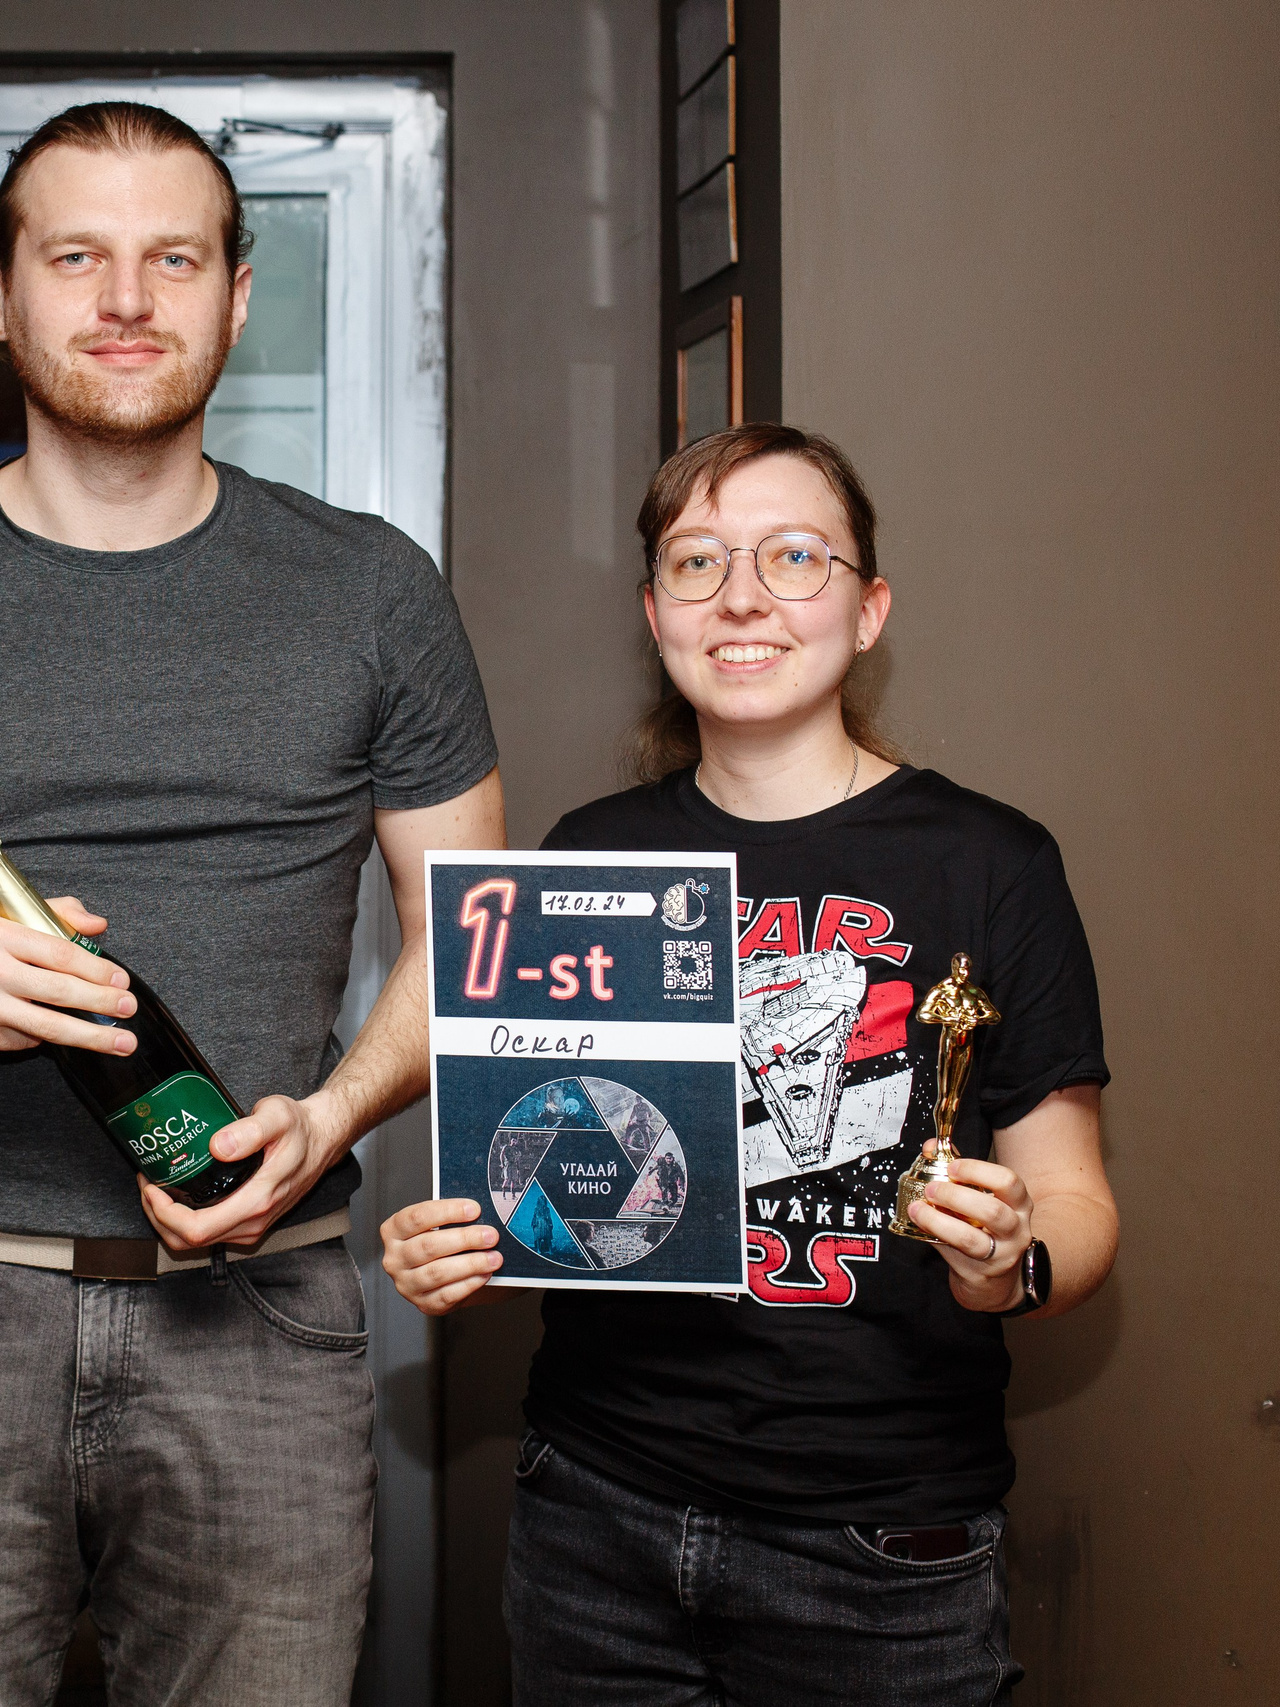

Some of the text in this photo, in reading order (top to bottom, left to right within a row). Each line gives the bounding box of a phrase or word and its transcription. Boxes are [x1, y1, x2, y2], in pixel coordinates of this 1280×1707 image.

[737, 893, 913, 967] AR
[663, 992, 714, 1001] vk.com/bigquiz
[490, 1024, 594, 1057] Оскар
[128, 1108, 198, 1156] BOSCA
[139, 1120, 210, 1166] ANNA FEDERICA
[560, 1160, 617, 1177] УГАДАЙ
[567, 1181, 611, 1195] КИНО
[746, 1224, 880, 1308] RS
